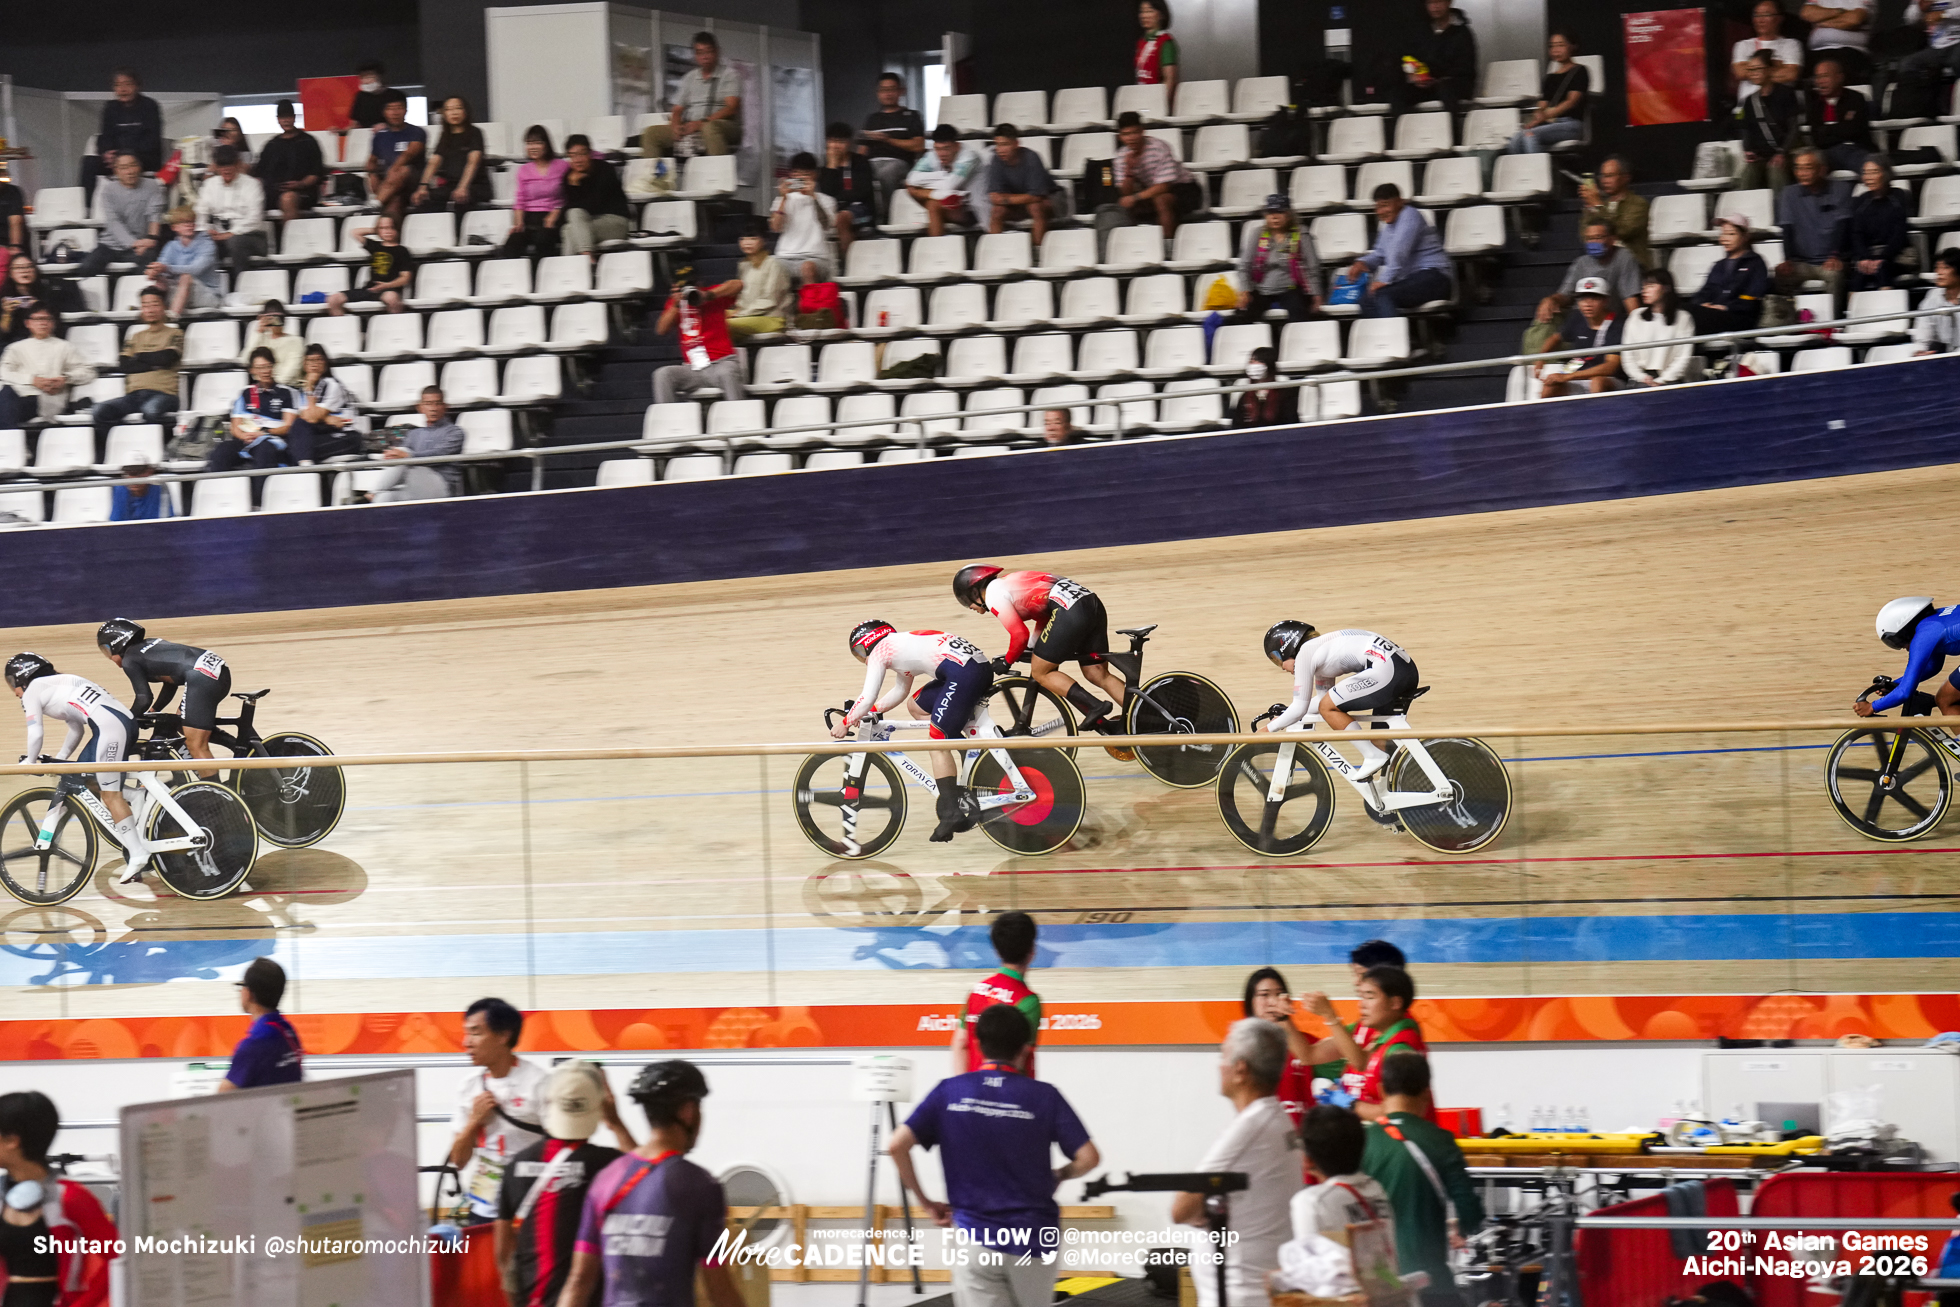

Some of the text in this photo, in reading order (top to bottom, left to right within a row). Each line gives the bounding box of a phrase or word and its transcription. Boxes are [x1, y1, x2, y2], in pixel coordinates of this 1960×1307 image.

[1041, 607, 1059, 644] CHINA
[80, 685, 102, 704] 111
[1346, 678, 1379, 693] KOREA
[934, 682, 958, 723] JAPAN
[106, 742, 119, 762] OREA
